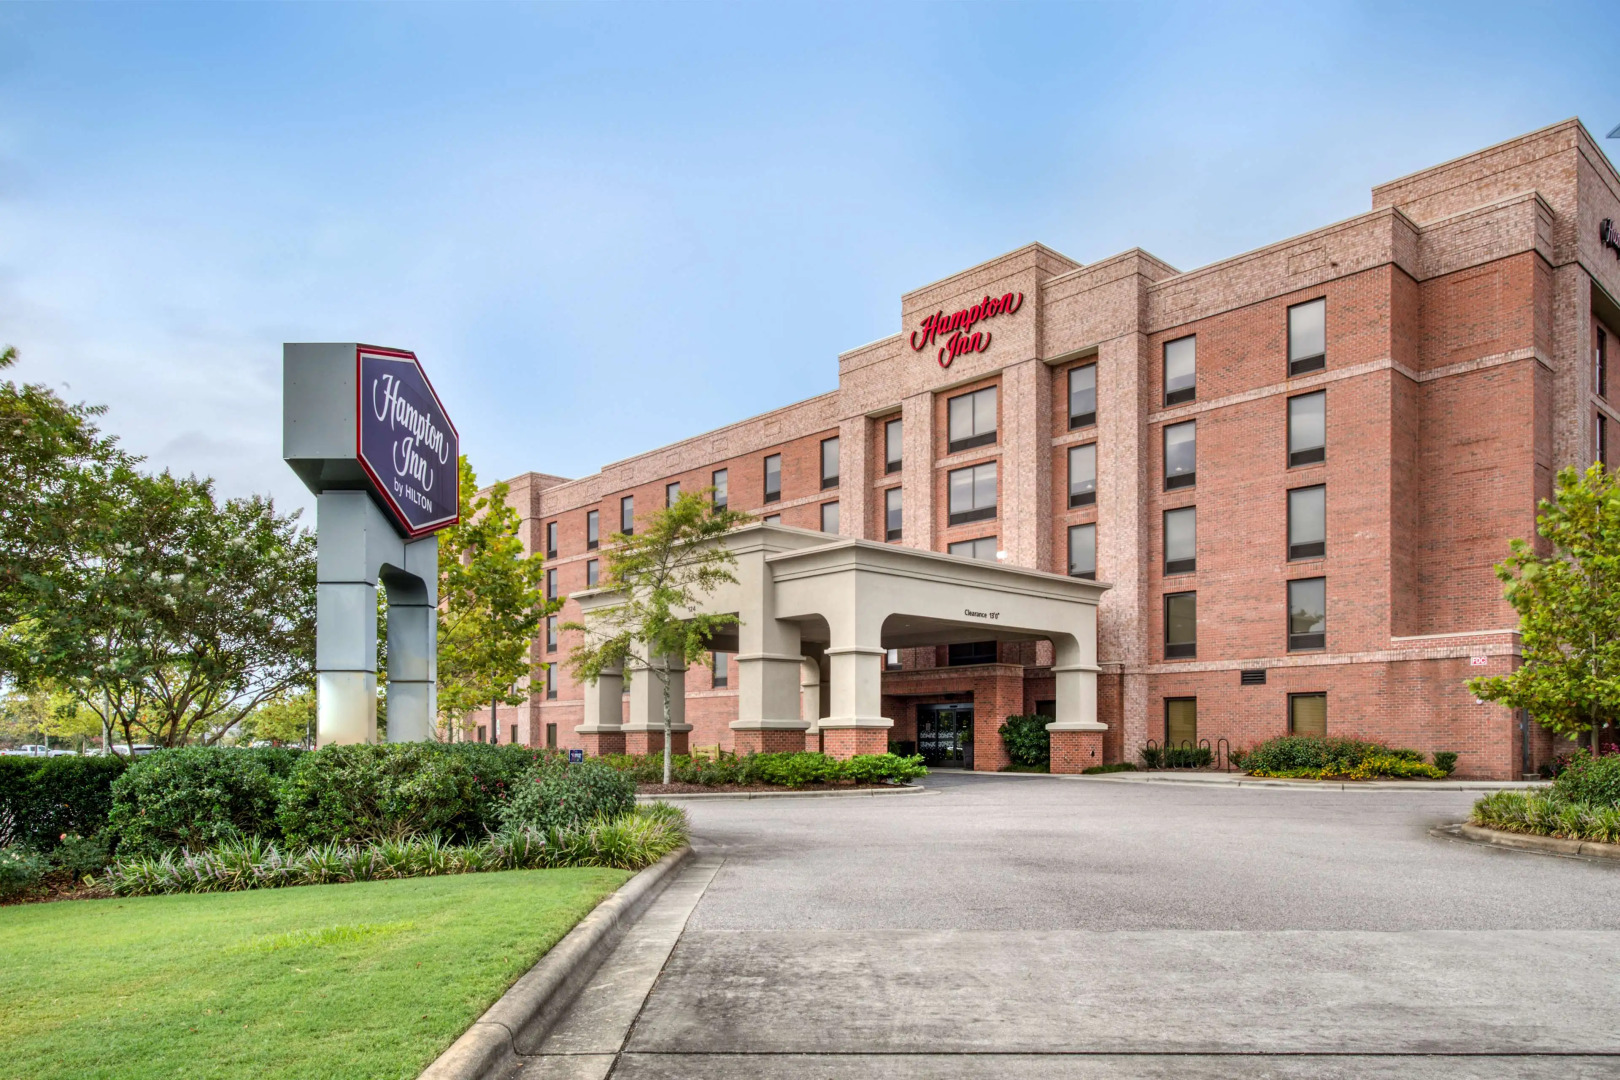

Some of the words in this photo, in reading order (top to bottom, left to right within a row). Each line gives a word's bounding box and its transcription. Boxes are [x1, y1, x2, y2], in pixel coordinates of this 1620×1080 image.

[910, 292, 1023, 351] Hampton
[938, 330, 991, 368] Inn
[373, 374, 449, 464] Hampton
[393, 437, 434, 492] Inn
[394, 477, 403, 497] by
[405, 484, 433, 513] HILTON
[964, 609, 987, 618] Clearance
